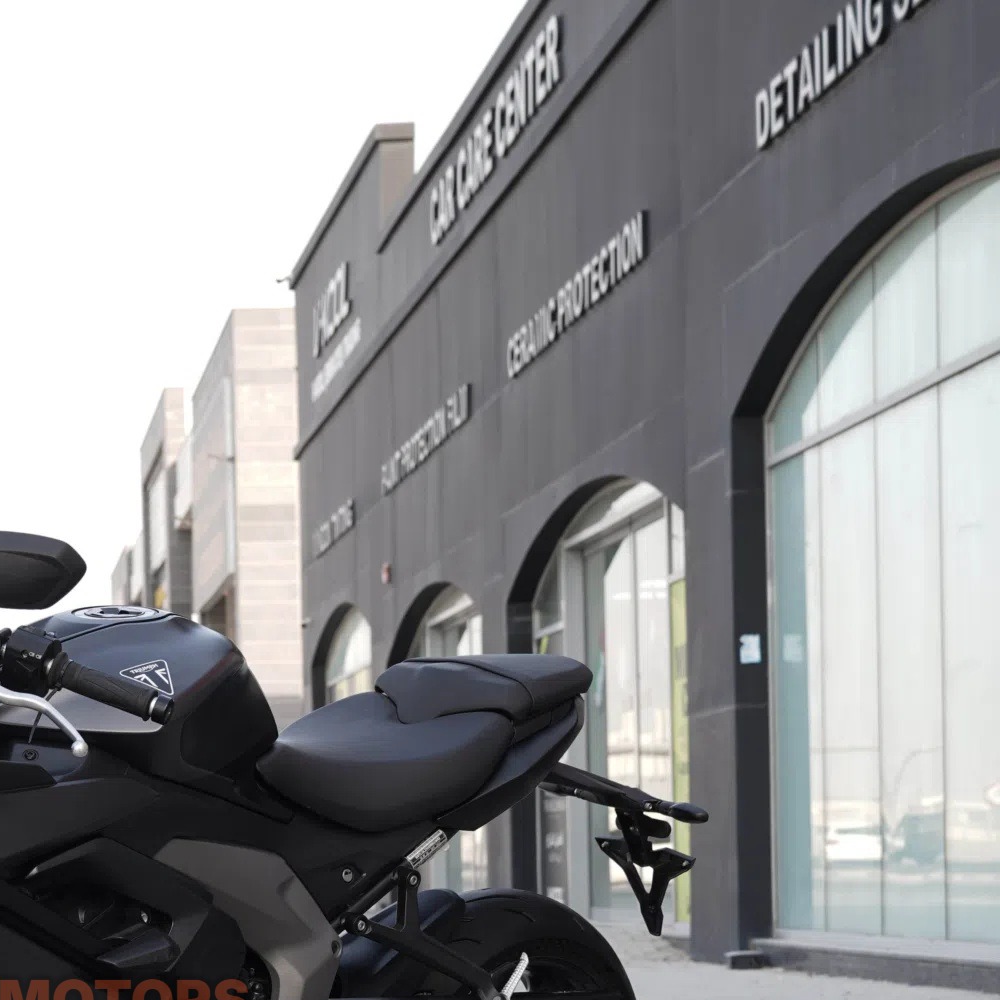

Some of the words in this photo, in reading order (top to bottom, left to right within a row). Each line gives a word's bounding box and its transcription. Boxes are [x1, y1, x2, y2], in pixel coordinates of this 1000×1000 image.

[430, 164, 455, 245] CAR
[457, 109, 493, 210] CARE
[495, 14, 560, 158] CENTER
[754, 0, 884, 150] DETAILING
[556, 211, 644, 335] PROTECTION
